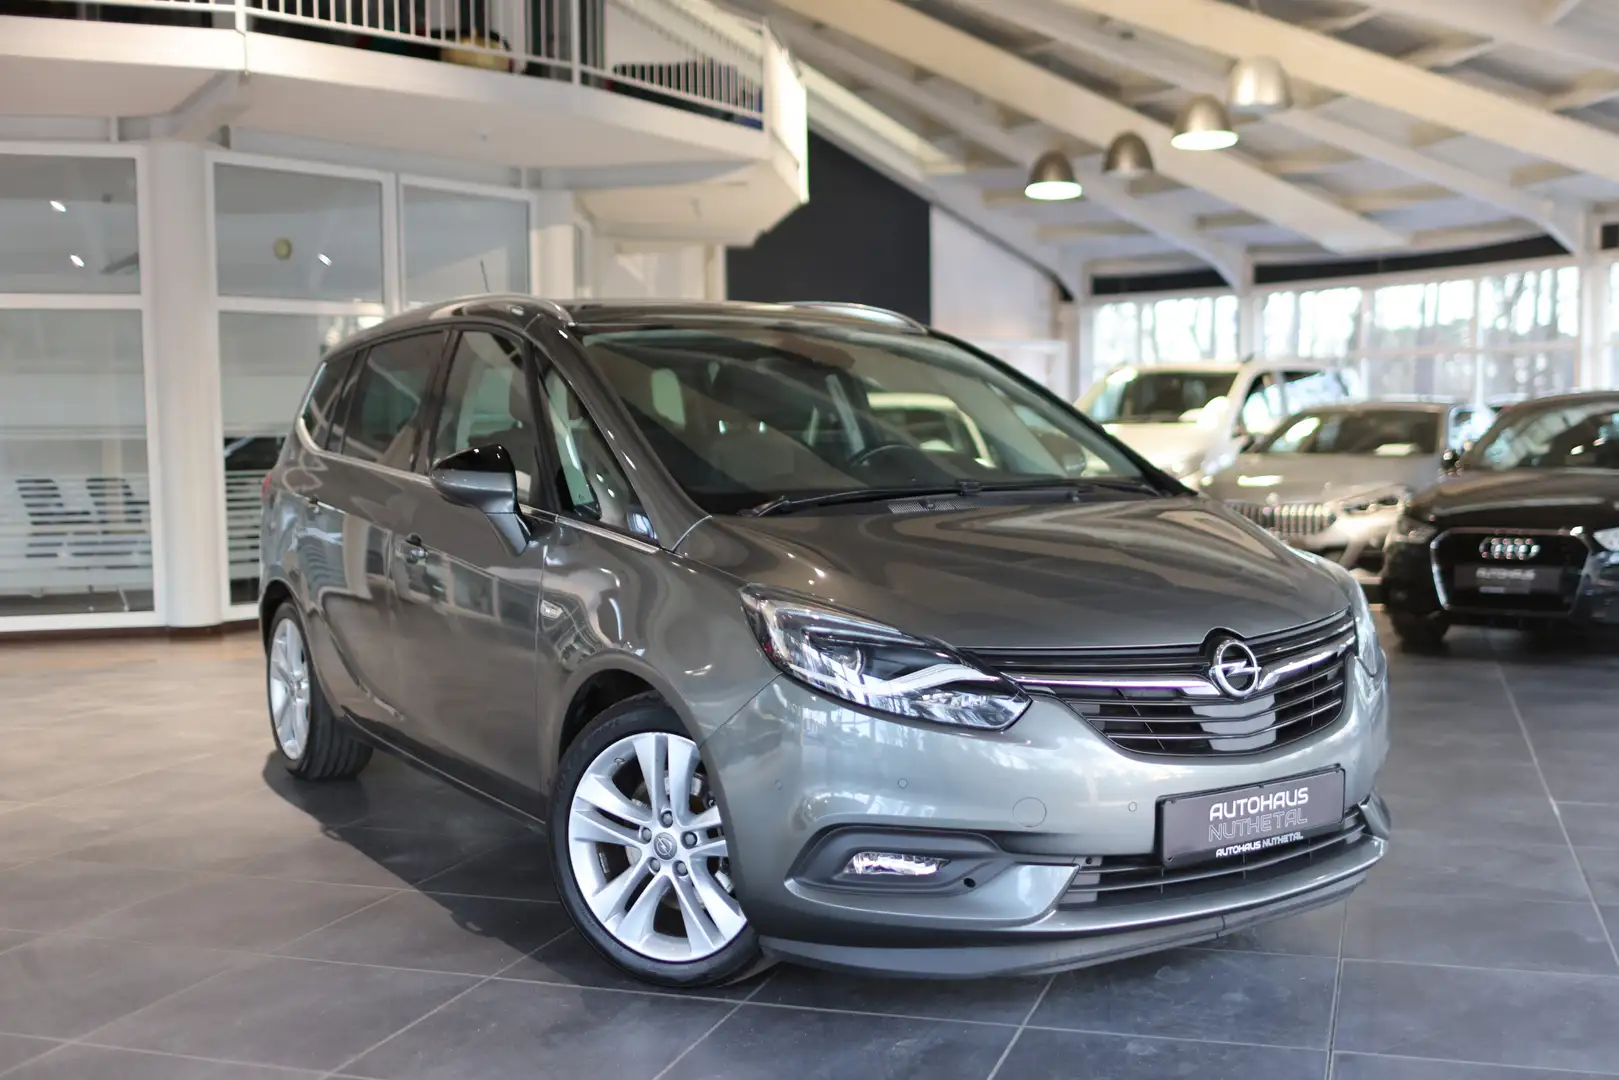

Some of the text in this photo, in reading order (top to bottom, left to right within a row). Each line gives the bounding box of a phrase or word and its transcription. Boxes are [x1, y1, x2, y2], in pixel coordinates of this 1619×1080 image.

[1209, 787, 1309, 822] AUTOHAUS
[1208, 808, 1308, 842] NUTHETAL
[1215, 832, 1304, 858] AUTOHAUS NUTHETAL
